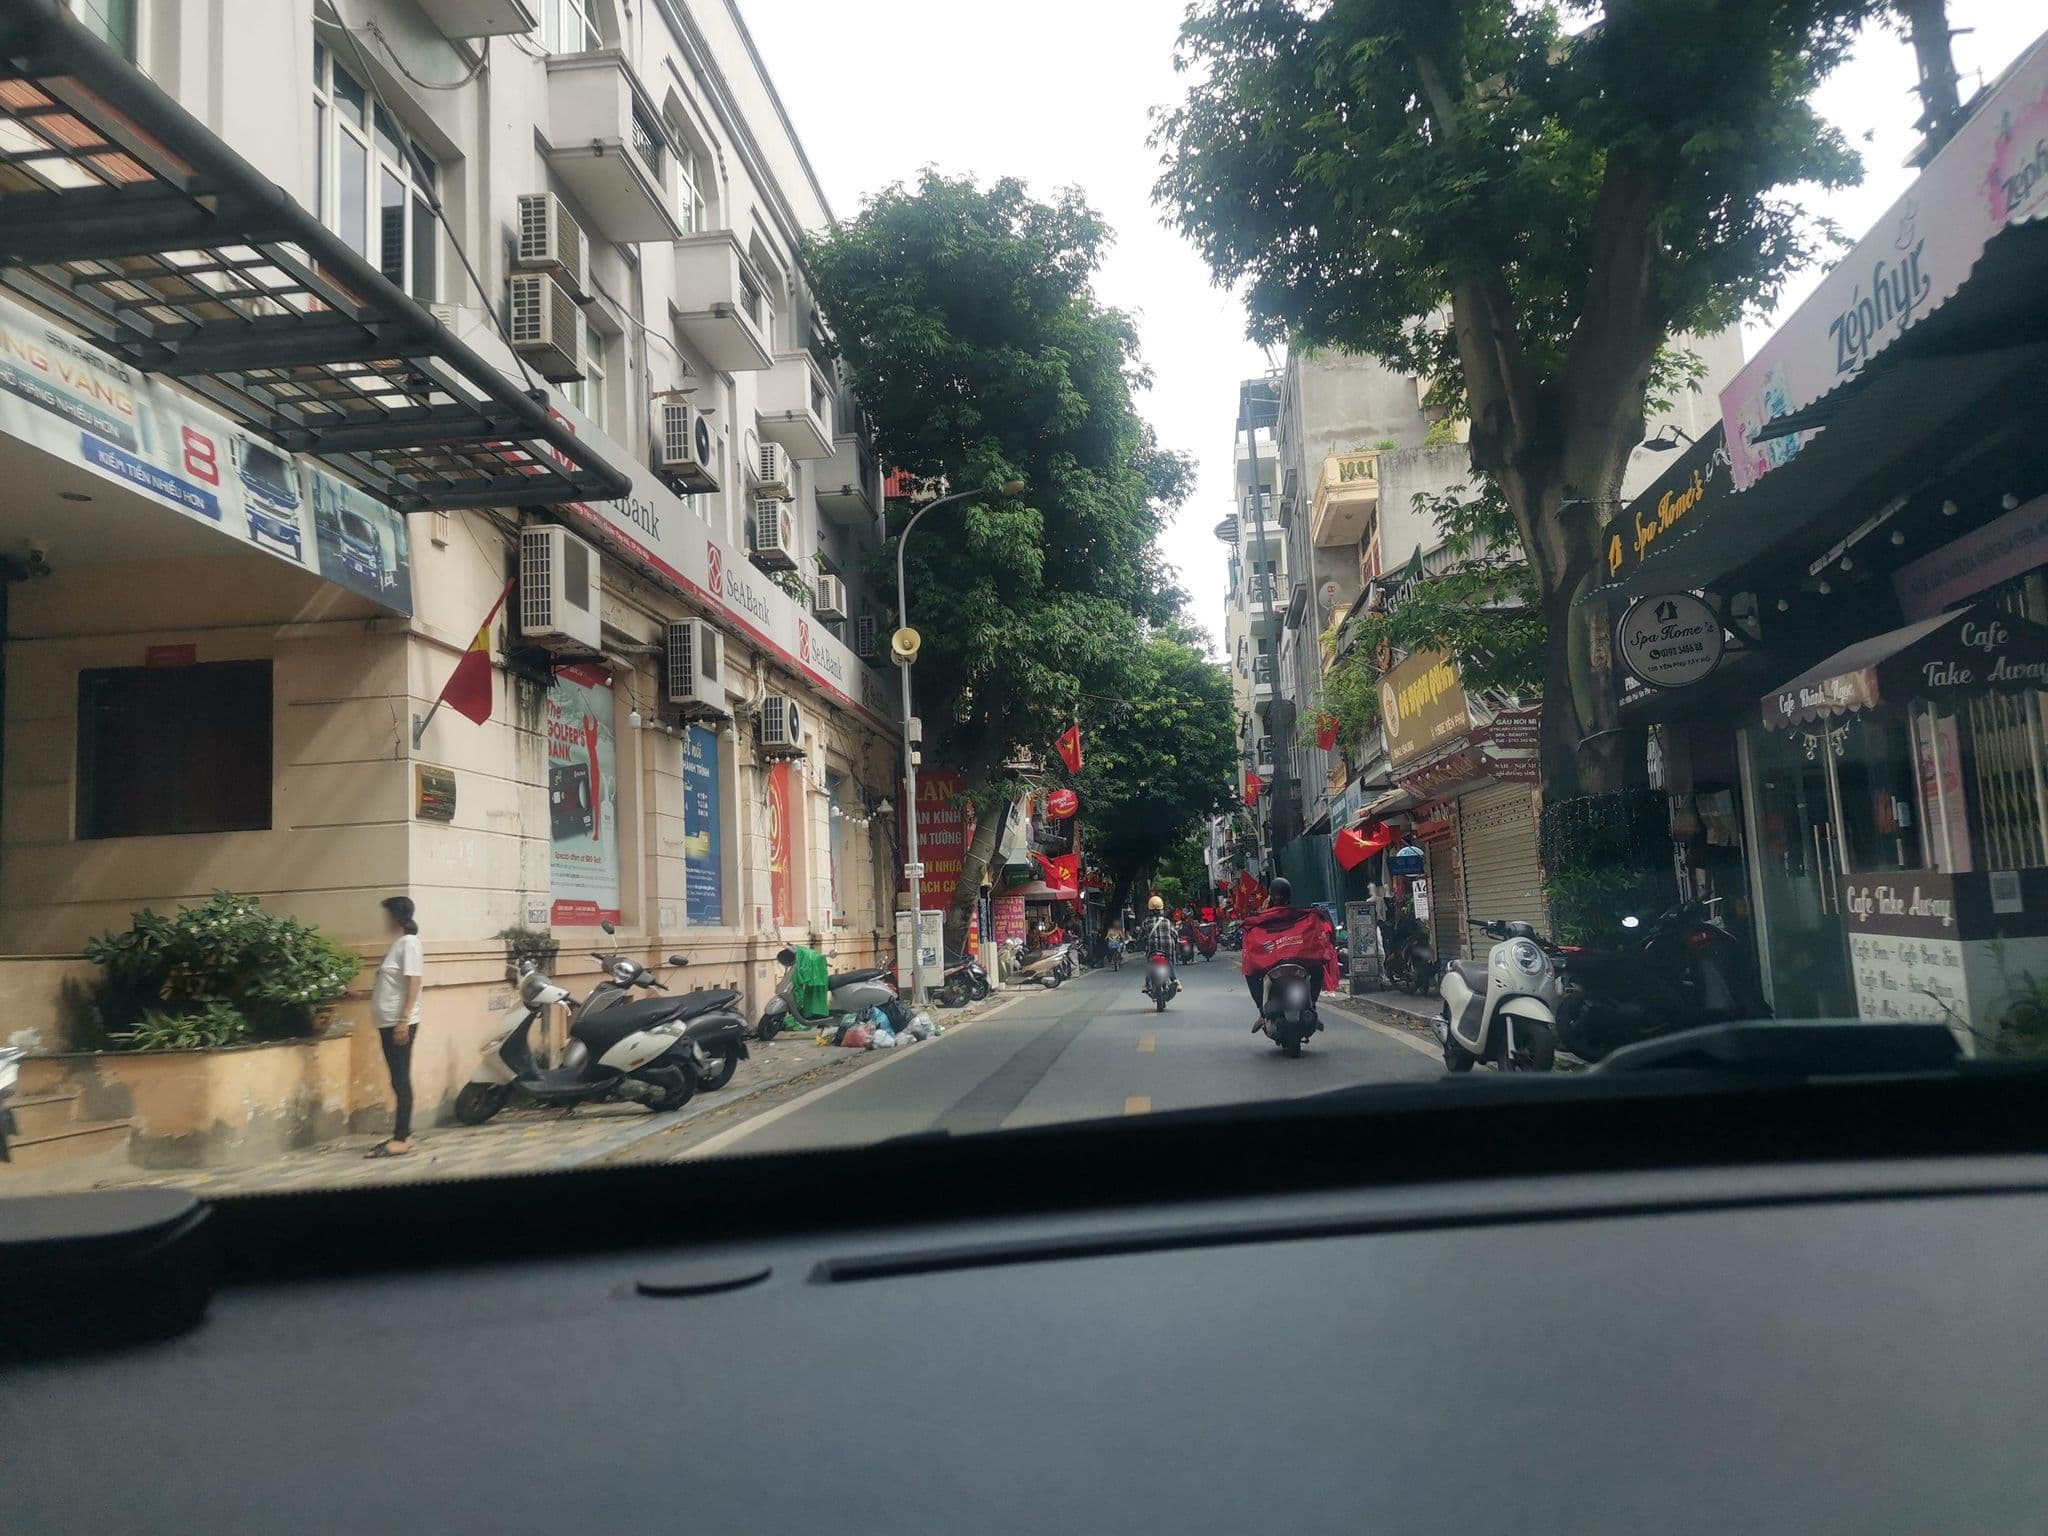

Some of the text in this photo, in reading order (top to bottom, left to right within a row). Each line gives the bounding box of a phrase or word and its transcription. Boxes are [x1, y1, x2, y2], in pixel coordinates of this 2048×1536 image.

[1828, 238, 1930, 376] Zéphyr
[182, 425, 219, 487] 8
[726, 569, 771, 626] SeABank
[1630, 630, 1659, 651] Spa
[1960, 620, 2009, 653] Cafe
[811, 637, 842, 683] SeABank
[1922, 661, 1974, 688] Take
[1779, 692, 1797, 717] Cafe
[1847, 885, 1874, 922] Cafe
